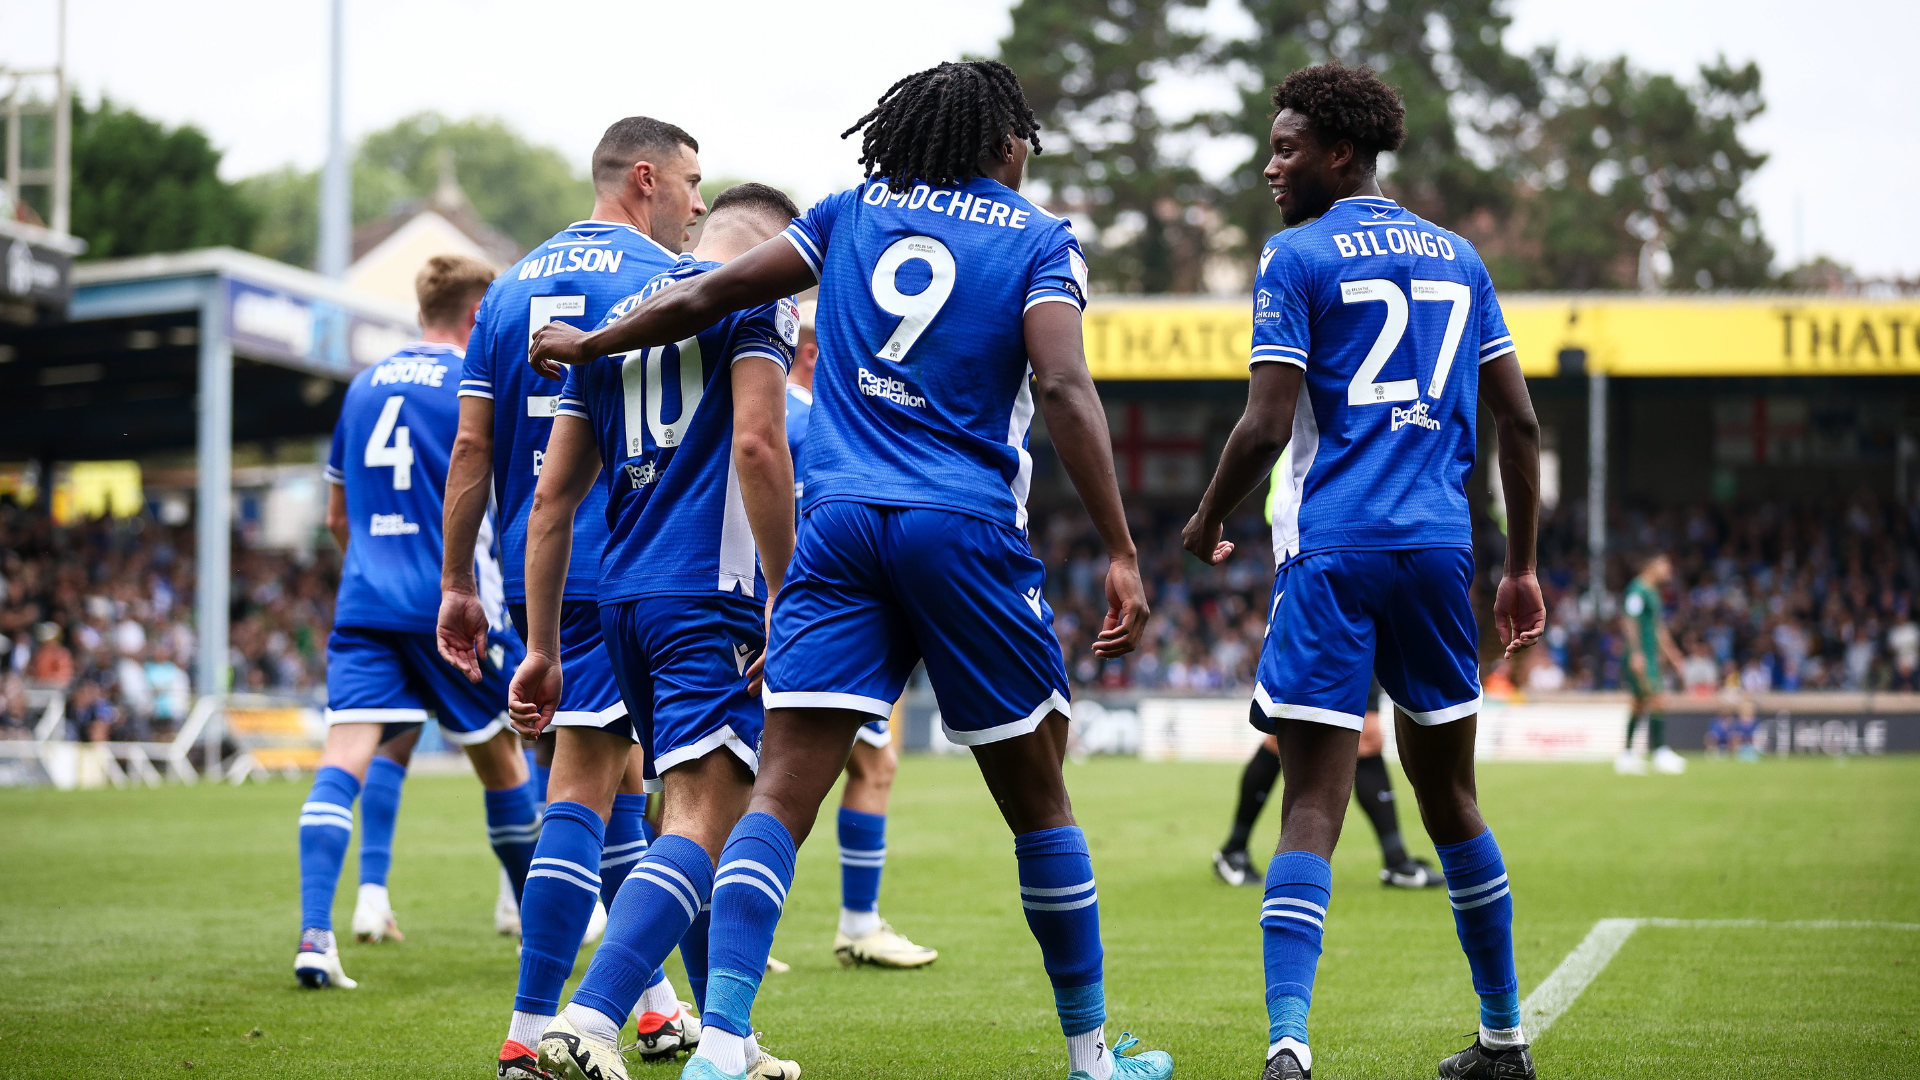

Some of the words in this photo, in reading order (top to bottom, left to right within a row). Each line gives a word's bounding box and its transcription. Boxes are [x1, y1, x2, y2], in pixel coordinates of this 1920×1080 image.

[518, 248, 624, 281] WILSON
[1332, 228, 1456, 261] BILONGO
[871, 235, 957, 363] 9
[528, 294, 586, 417] 5
[1339, 278, 1471, 406] 27
[1769, 308, 1920, 357] THAT
[370, 362, 449, 388] MOORE
[607, 335, 704, 458] 10
[858, 367, 906, 392] Poplar
[858, 382, 927, 409] Insulation
[363, 395, 415, 490] 4
